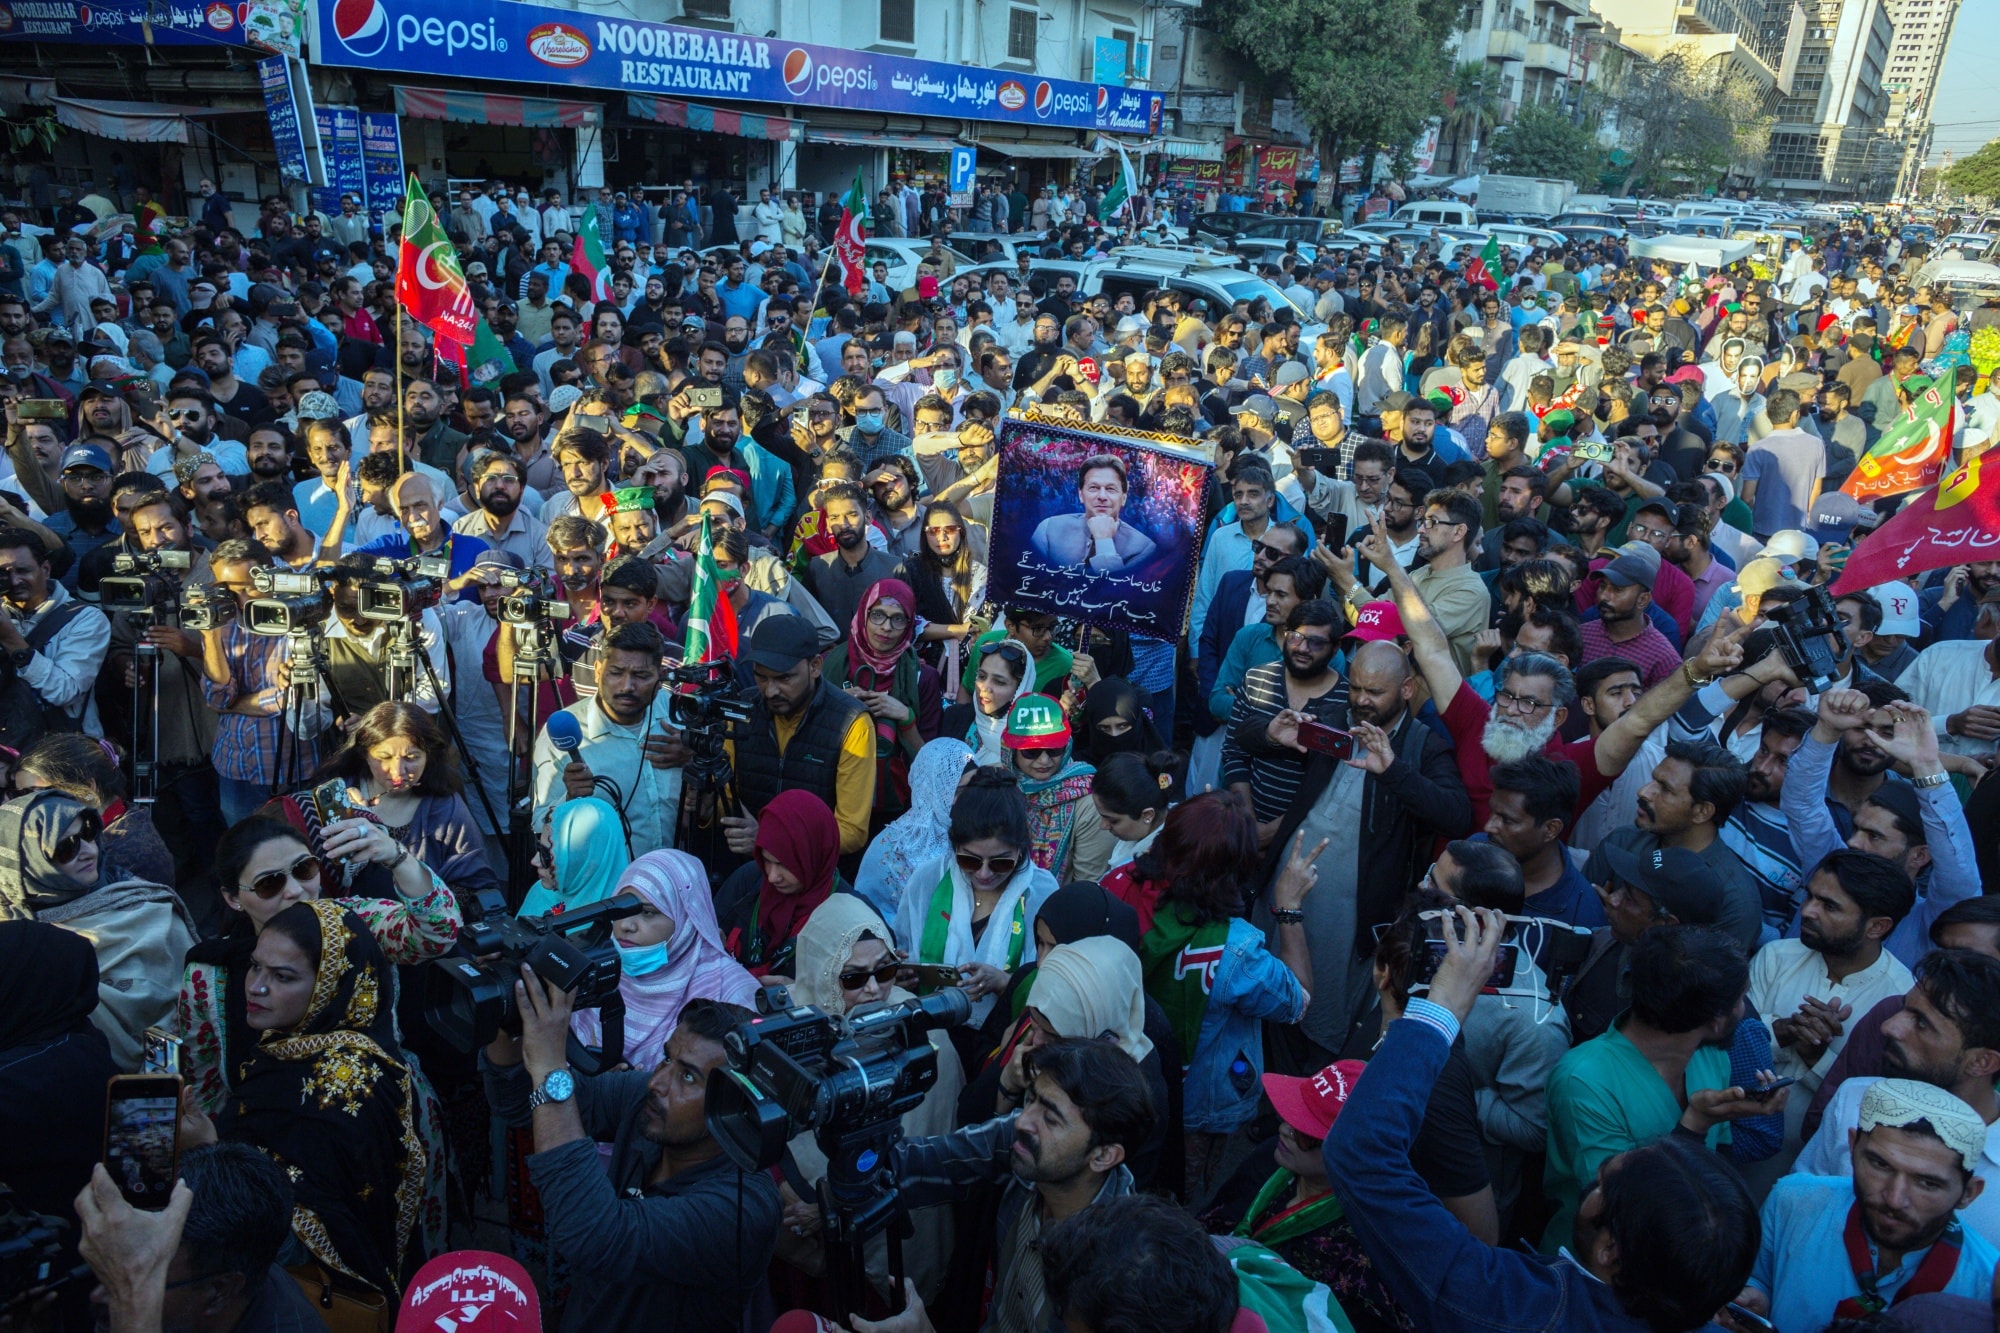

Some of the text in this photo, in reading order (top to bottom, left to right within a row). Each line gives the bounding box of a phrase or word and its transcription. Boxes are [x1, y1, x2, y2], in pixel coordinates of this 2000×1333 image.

[10, 2, 78, 19] NOOREBAHAR
[94, 9, 122, 28] pepsi
[22, 21, 72, 34] RESTAURANT
[597, 21, 771, 69] NOOREBAHAR
[621, 60, 751, 92] RESTAURANT
[957, 152, 971, 183] P
[440, 309, 475, 332] NA-244
[1819, 513, 1842, 525] USAF
[1085, 568, 1105, 584] آپ
[1055, 583, 1089, 606] نہیں
[1141, 580, 1162, 593] خان
[1080, 600, 1113, 613] سب
[1109, 599, 1129, 621] ہم
[1126, 610, 1157, 624] جب
[1017, 706, 1051, 724] PTI
[411, 1264, 528, 1307] پاکستان تحریک انصاف
[451, 1289, 496, 1303] PTI
